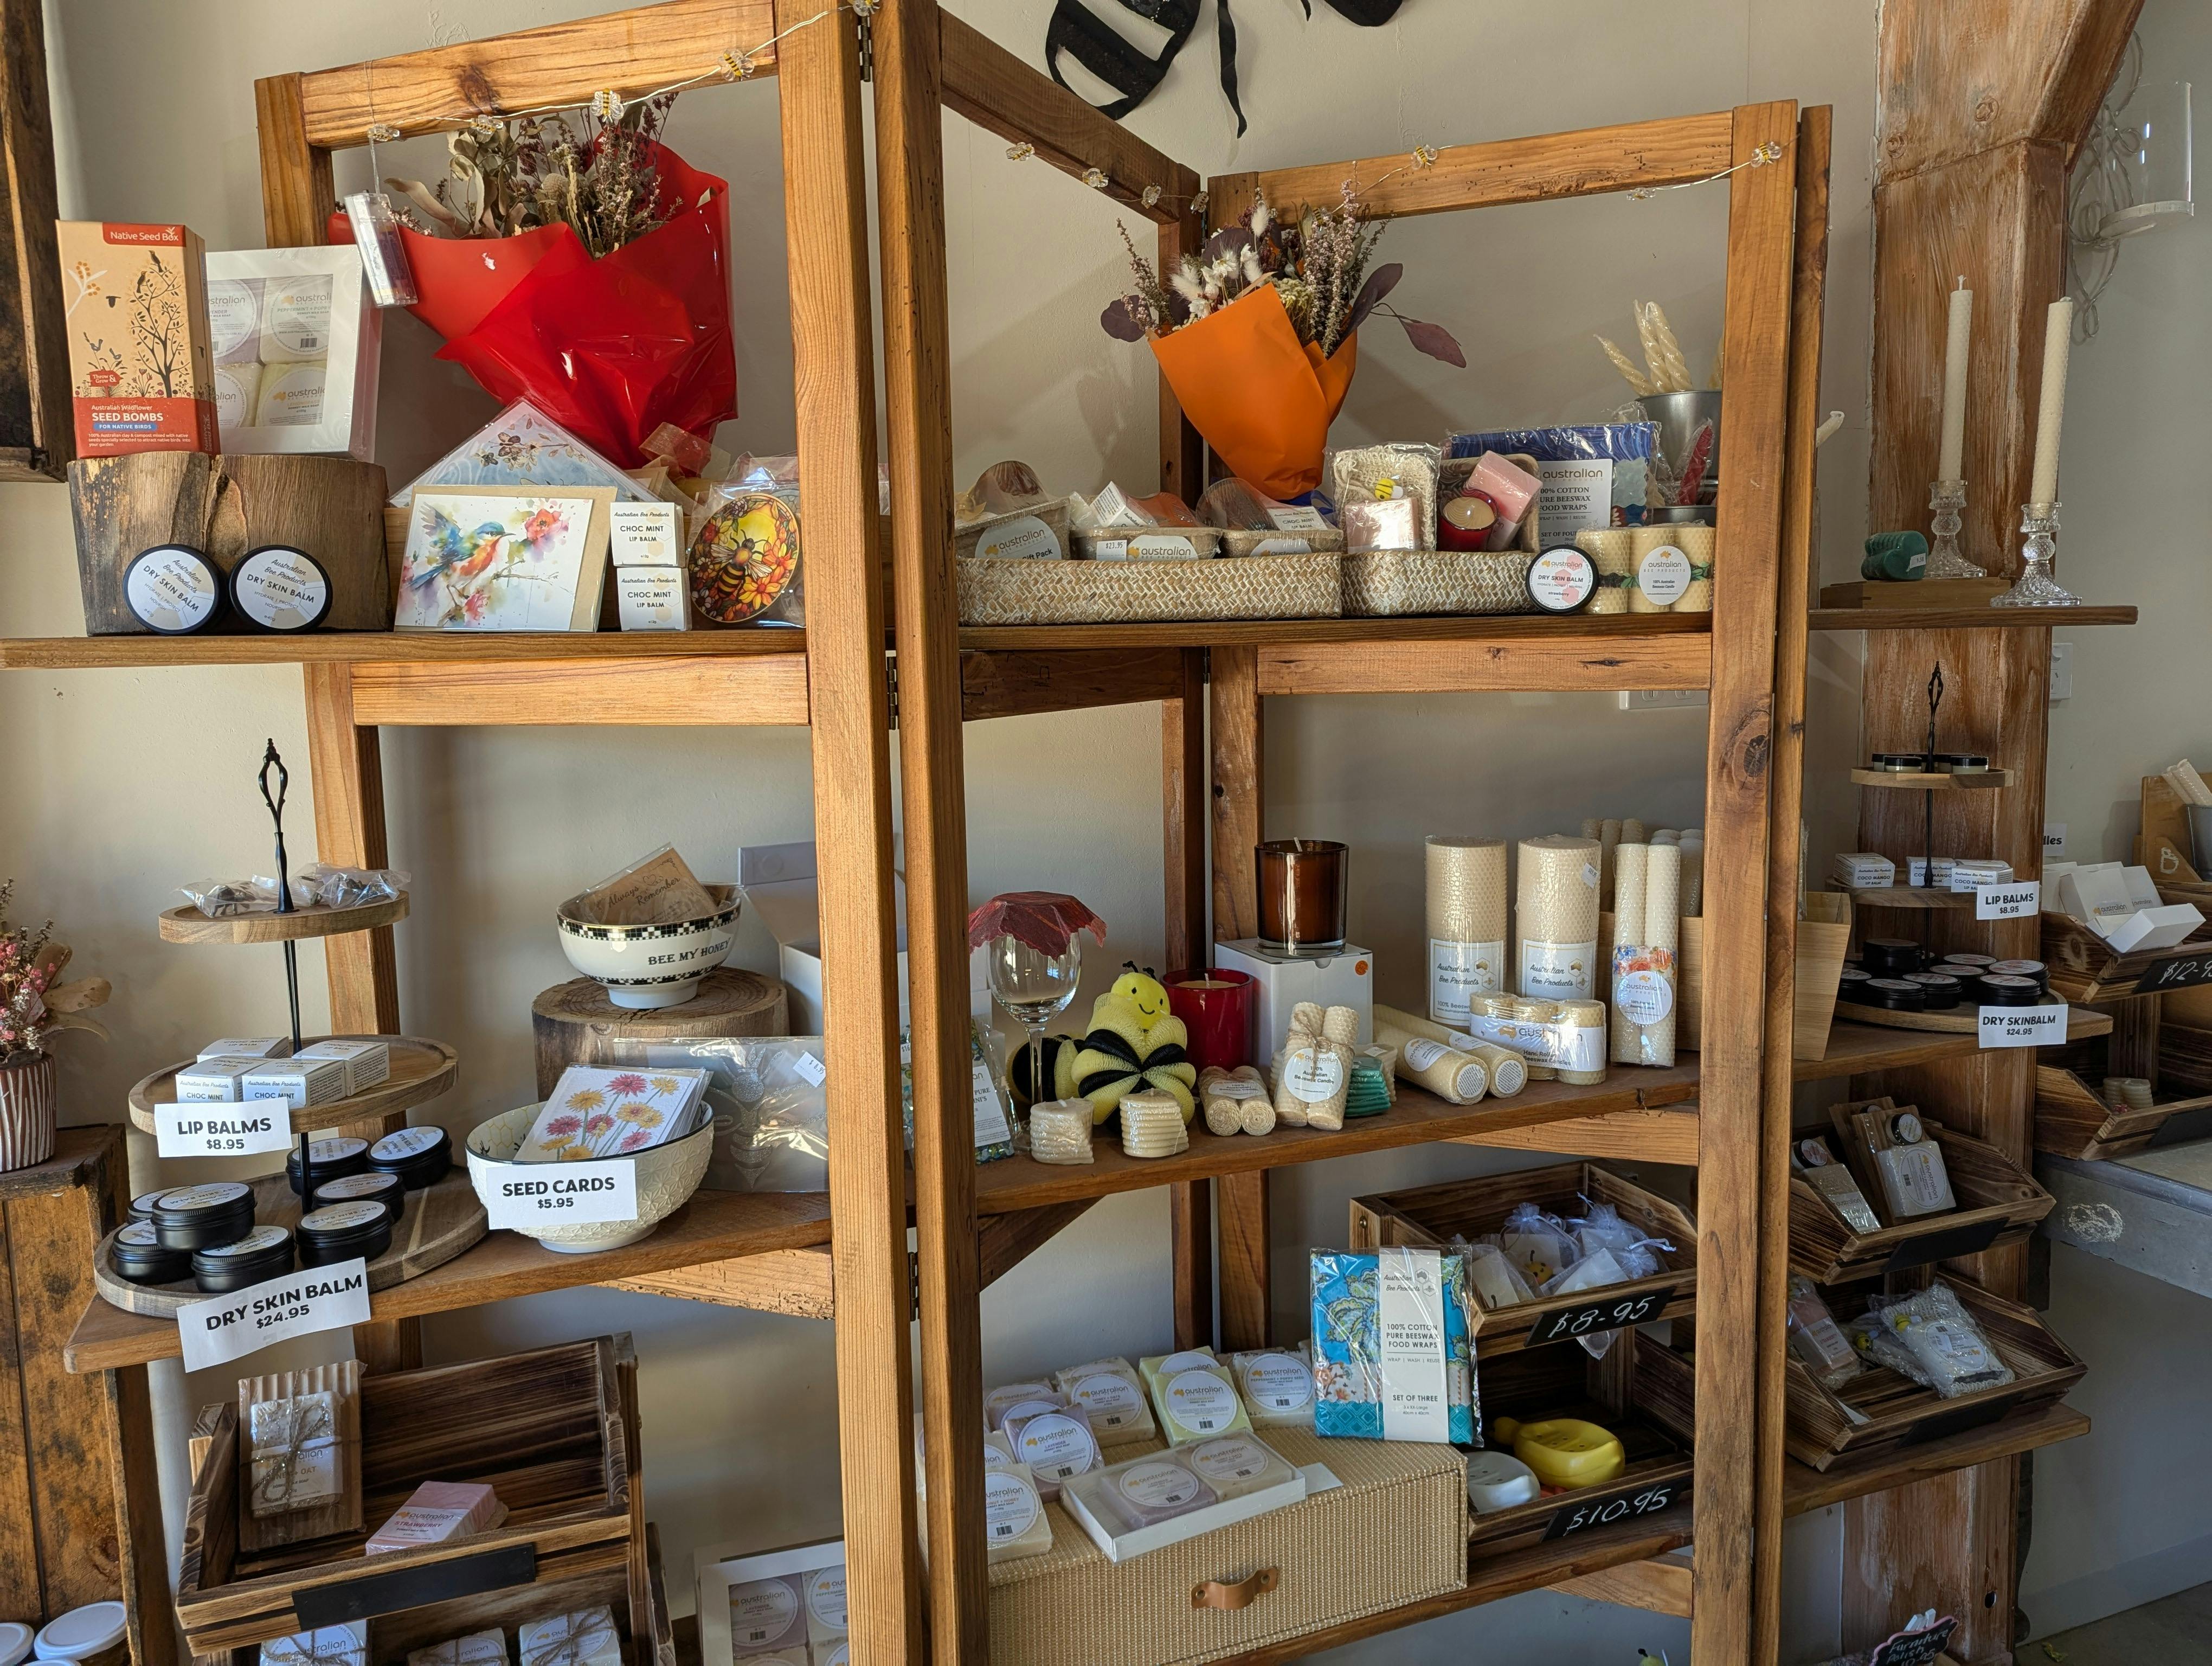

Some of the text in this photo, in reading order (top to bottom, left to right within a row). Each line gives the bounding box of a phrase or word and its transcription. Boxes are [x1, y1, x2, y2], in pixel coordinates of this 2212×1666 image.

[111, 232, 137, 240] Native
[109, 374, 117, 382] &
[92, 413, 164, 421] SEED BOMBS
[1543, 468, 1603, 479] australian
[999, 529, 1045, 549] australian
[1036, 548, 1053, 559] Pack
[1141, 546, 1191, 555] australian
[172, 559, 202, 585] Australian
[271, 559, 306, 576] Australian
[163, 563, 198, 594] Bee Products
[264, 567, 306, 586] Bee Products
[143, 565, 200, 612] DRY SKIN BALM
[247, 574, 315, 604] DRY SKIN BALM
[2160, 847, 2179, 874] B
[609, 886, 639, 907] Always
[636, 877, 680, 906] Remember
[1985, 893, 2034, 905] LIP BALMS
[1999, 906, 2019, 914] $8.95
[2101, 904, 2127, 912] australian
[648, 937, 731, 966] BEE MY HONEY
[1437, 963, 1470, 972] Australian
[1530, 964, 1564, 974] Australian
[1450, 977, 1479, 985] Products
[1544, 977, 1573, 986] Products
[1983, 1015, 2056, 1026] DRY SKINBALM
[2006, 1028, 2032, 1036] $24.95
[974, 1087, 991, 1095] PURE
[177, 1117, 272, 1136] LIP BALMS
[206, 1138, 245, 1150] $8.95
[502, 1177, 616, 1197] SEED CARDS
[537, 1197, 574, 1209] $5.95
[205, 1274, 362, 1331] DRY SKIN BALM
[256, 1304, 310, 1329] $24.95
[1091, 1386, 1128, 1395] australian
[1185, 1386, 1223, 1394] australian
[1038, 1427, 1077, 1442] australian
[301, 1466, 317, 1475] OAT
[986, 1487, 1024, 1498] ustralian
[741, 1591, 785, 1604] australian
